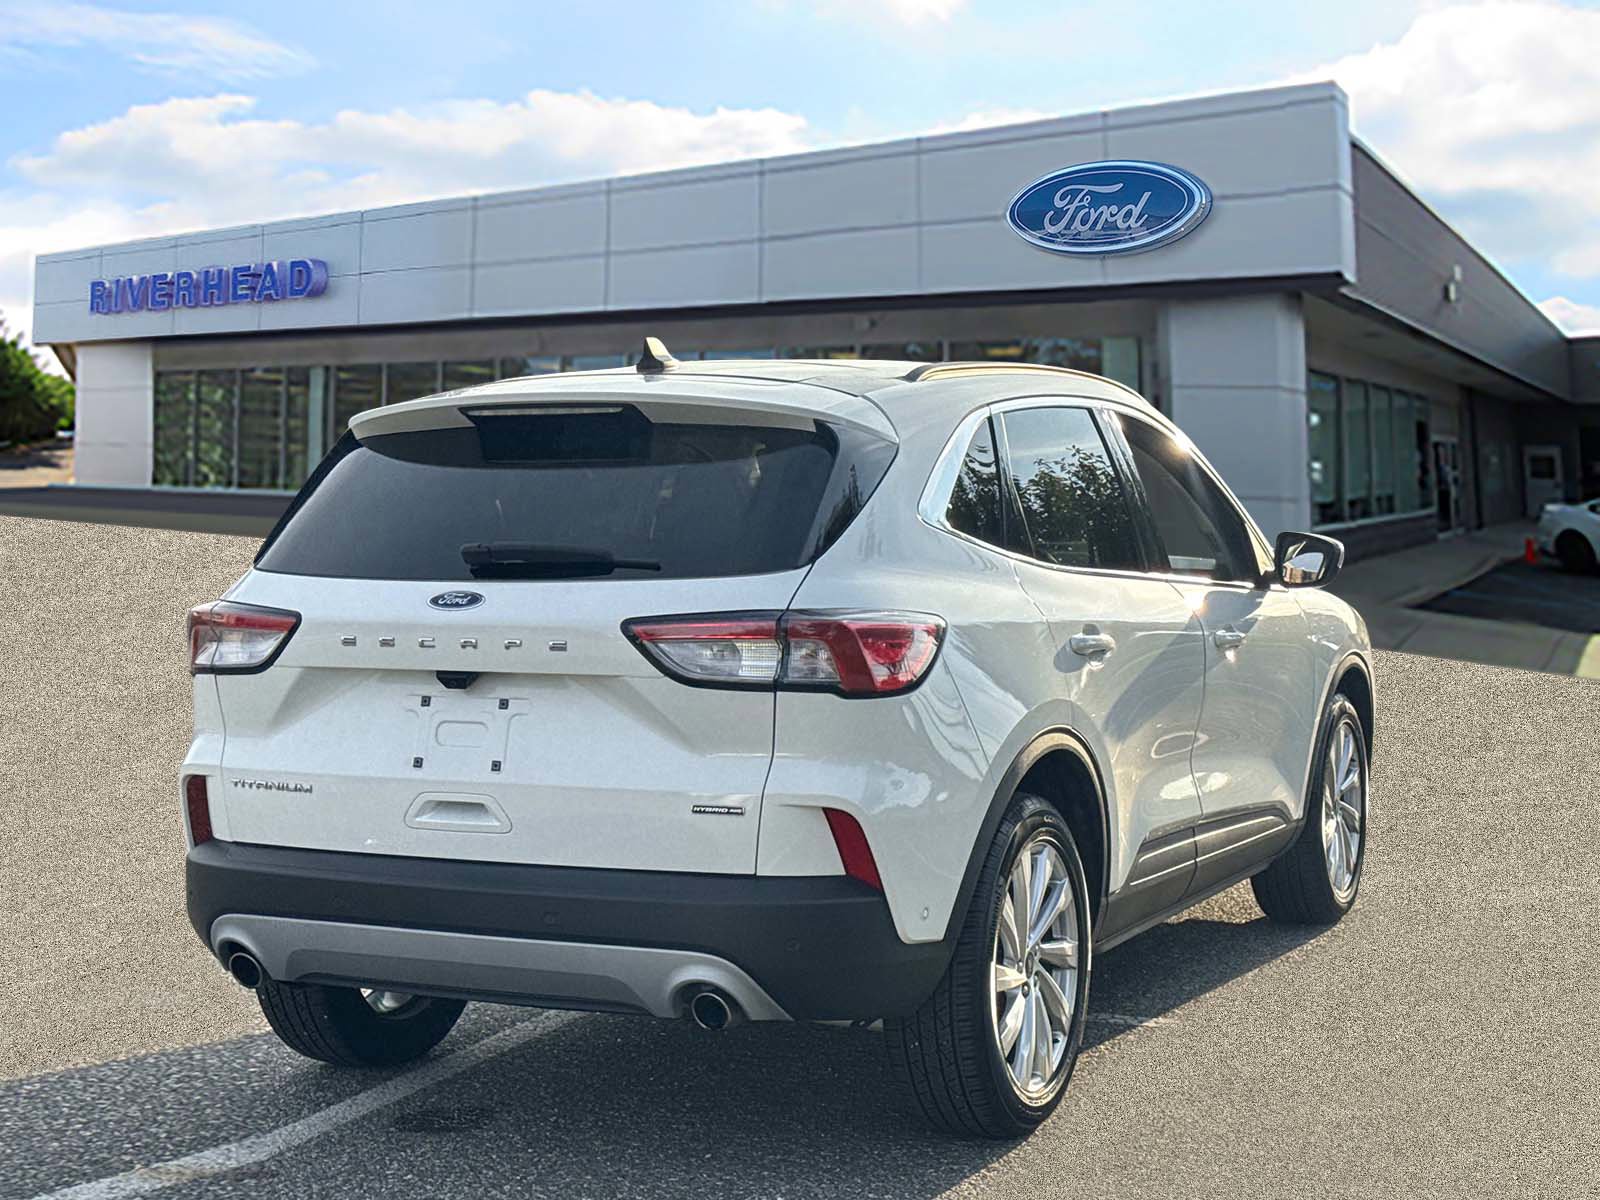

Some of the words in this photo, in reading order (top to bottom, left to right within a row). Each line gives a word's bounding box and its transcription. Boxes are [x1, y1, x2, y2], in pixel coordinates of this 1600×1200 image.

[1043, 182, 1152, 234] Ford
[89, 258, 326, 314] RIVERHEAD
[438, 592, 472, 605] Ford
[340, 634, 568, 652] ESCAPE
[231, 778, 313, 794] TITANIUM
